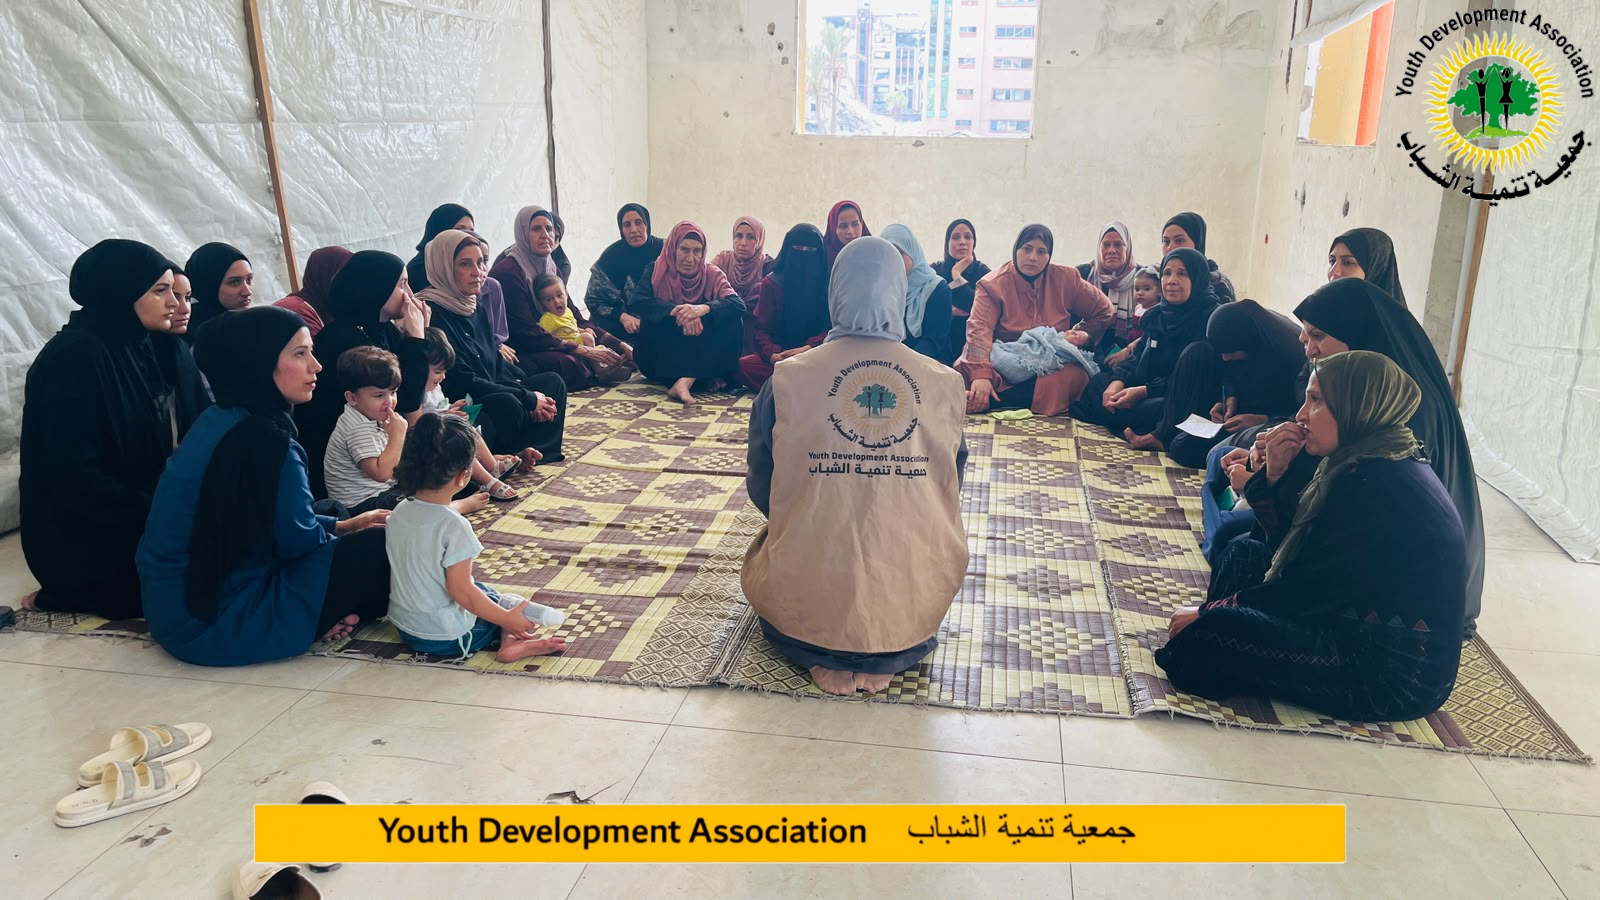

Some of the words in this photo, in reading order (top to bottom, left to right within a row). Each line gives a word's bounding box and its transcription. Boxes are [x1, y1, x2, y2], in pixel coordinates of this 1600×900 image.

[827, 374, 844, 398] Youth
[840, 359, 892, 377] Development
[893, 364, 921, 404] Association
[808, 452, 830, 460] Youth
[832, 452, 888, 462] Development
[808, 461, 850, 476] الشباب
[854, 463, 891, 478] تنمية
